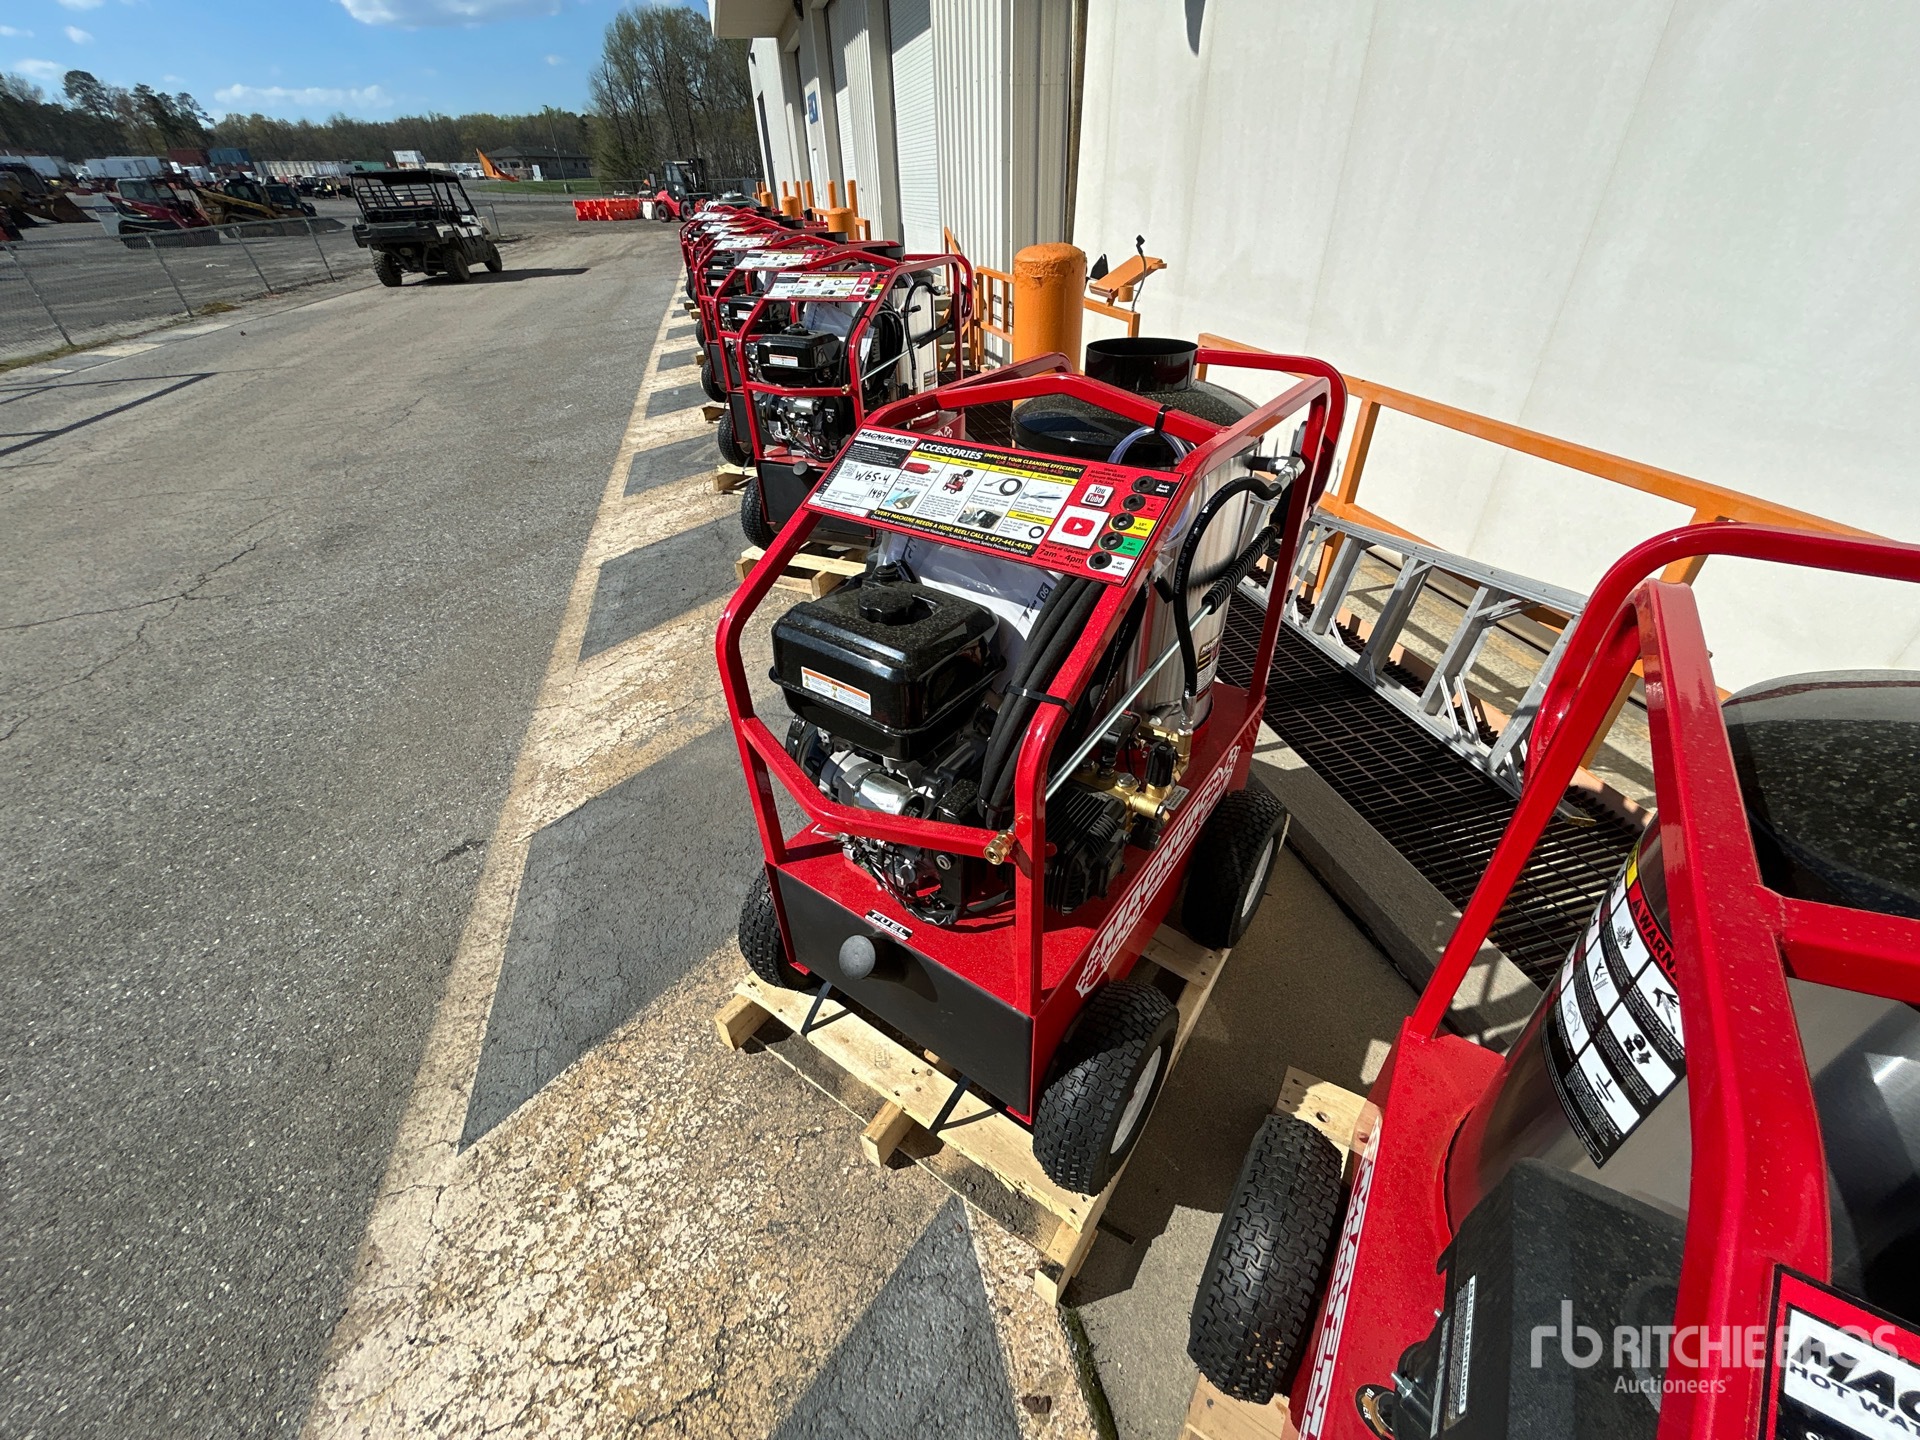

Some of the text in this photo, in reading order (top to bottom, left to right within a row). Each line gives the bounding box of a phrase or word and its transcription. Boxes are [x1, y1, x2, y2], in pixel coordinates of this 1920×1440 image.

[858, 431, 893, 440] MAGNUM
[894, 437, 916, 446] 4000
[917, 443, 983, 460] ACCESSORIES
[984, 453, 1007, 461] IMPROVE
[1023, 459, 1050, 468] CLEANING
[1050, 464, 1083, 473] EFFICIENCY
[1087, 494, 1104, 504] Tube
[1094, 486, 1106, 495] You
[874, 510, 890, 518] EVERY
[890, 514, 915, 522] MACHINE
[915, 519, 933, 527] NEEDS
[970, 531, 984, 540] CALL
[985, 535, 1033, 550] 1-877-441-4430
[1039, 549, 1057, 558] 7am
[1065, 554, 1084, 564] 4pm
[1038, 585, 1051, 600] 06
[1144, 824, 1197, 908] SERIES
[1099, 799, 1205, 952] MAGNUM
[872, 913, 906, 935] FUEL
[1789, 1361, 1851, 1399] HOT
